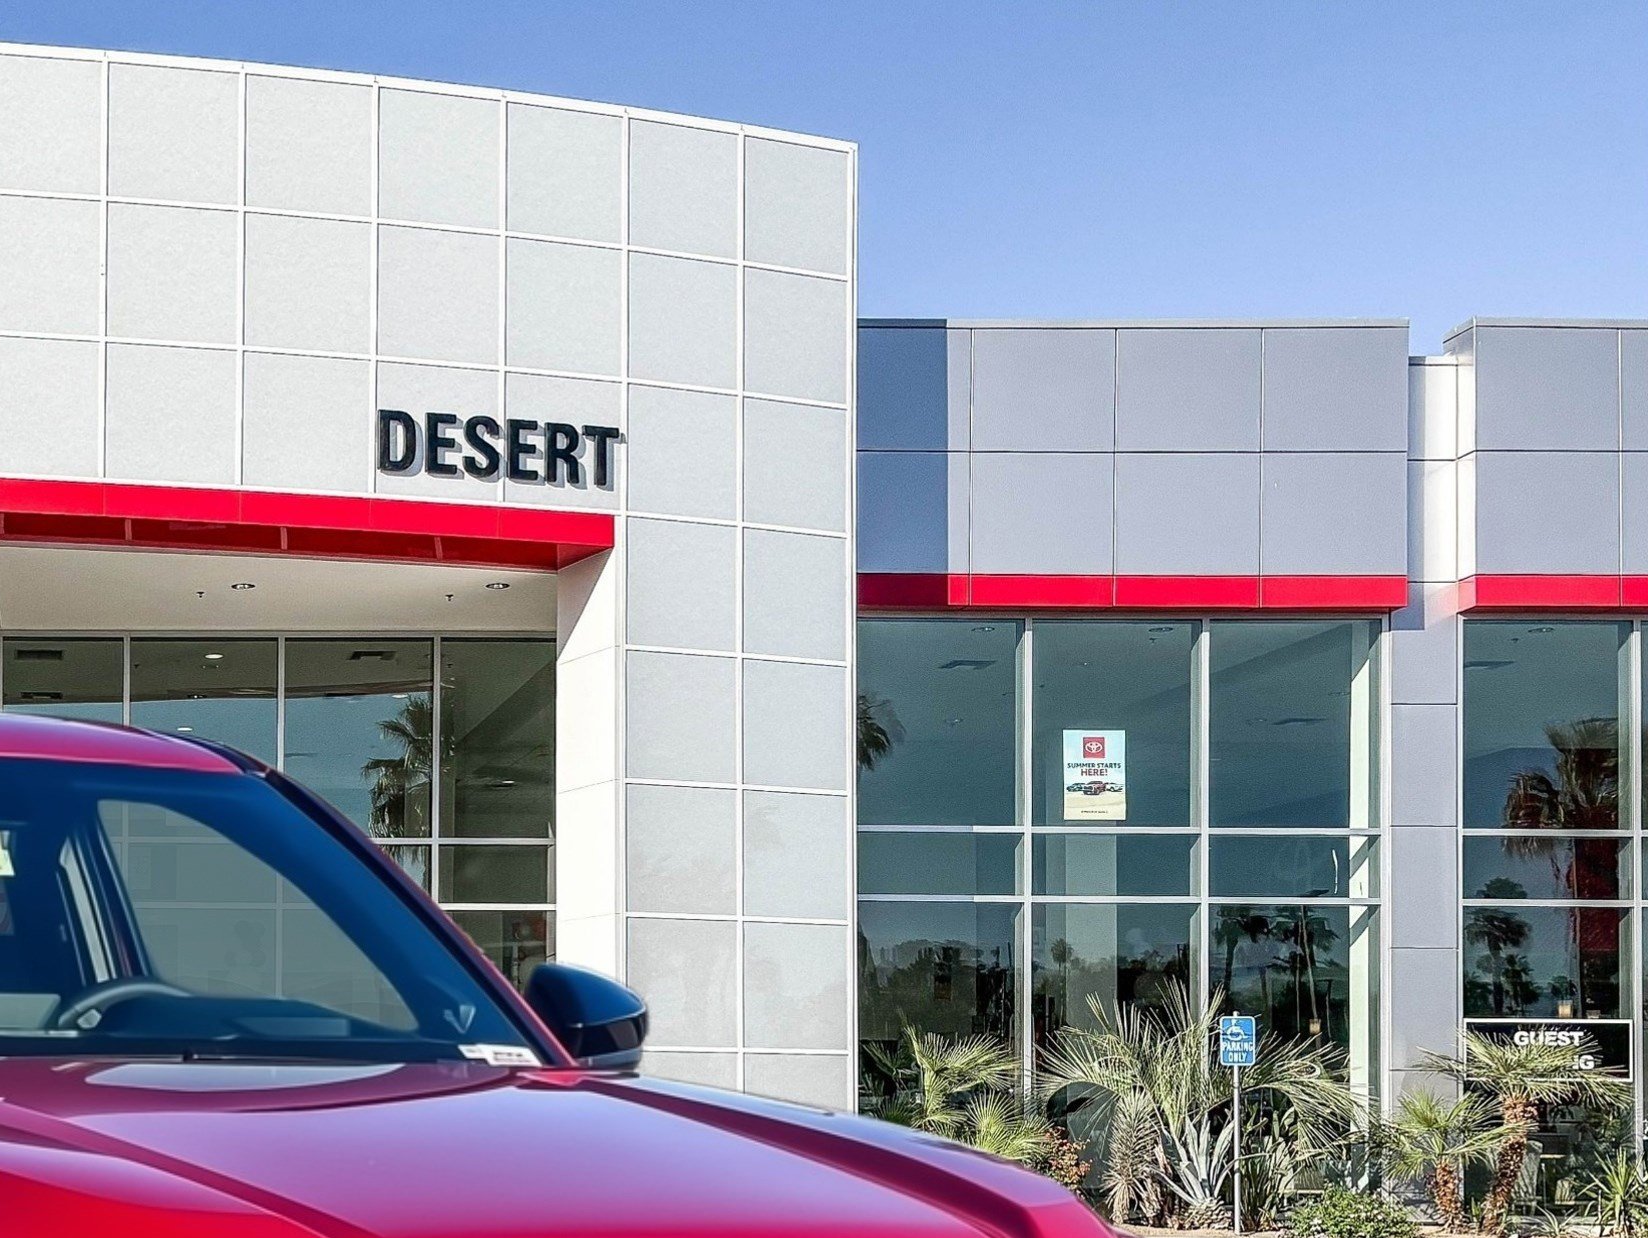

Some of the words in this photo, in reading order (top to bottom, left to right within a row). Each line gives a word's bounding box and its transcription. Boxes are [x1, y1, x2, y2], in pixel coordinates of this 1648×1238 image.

[377, 409, 620, 487] DESERT
[1080, 768, 1108, 776] HERE!
[1513, 1030, 1585, 1047] GUEST
[1222, 1040, 1254, 1052] PARKING
[1228, 1051, 1248, 1063] ONLY
